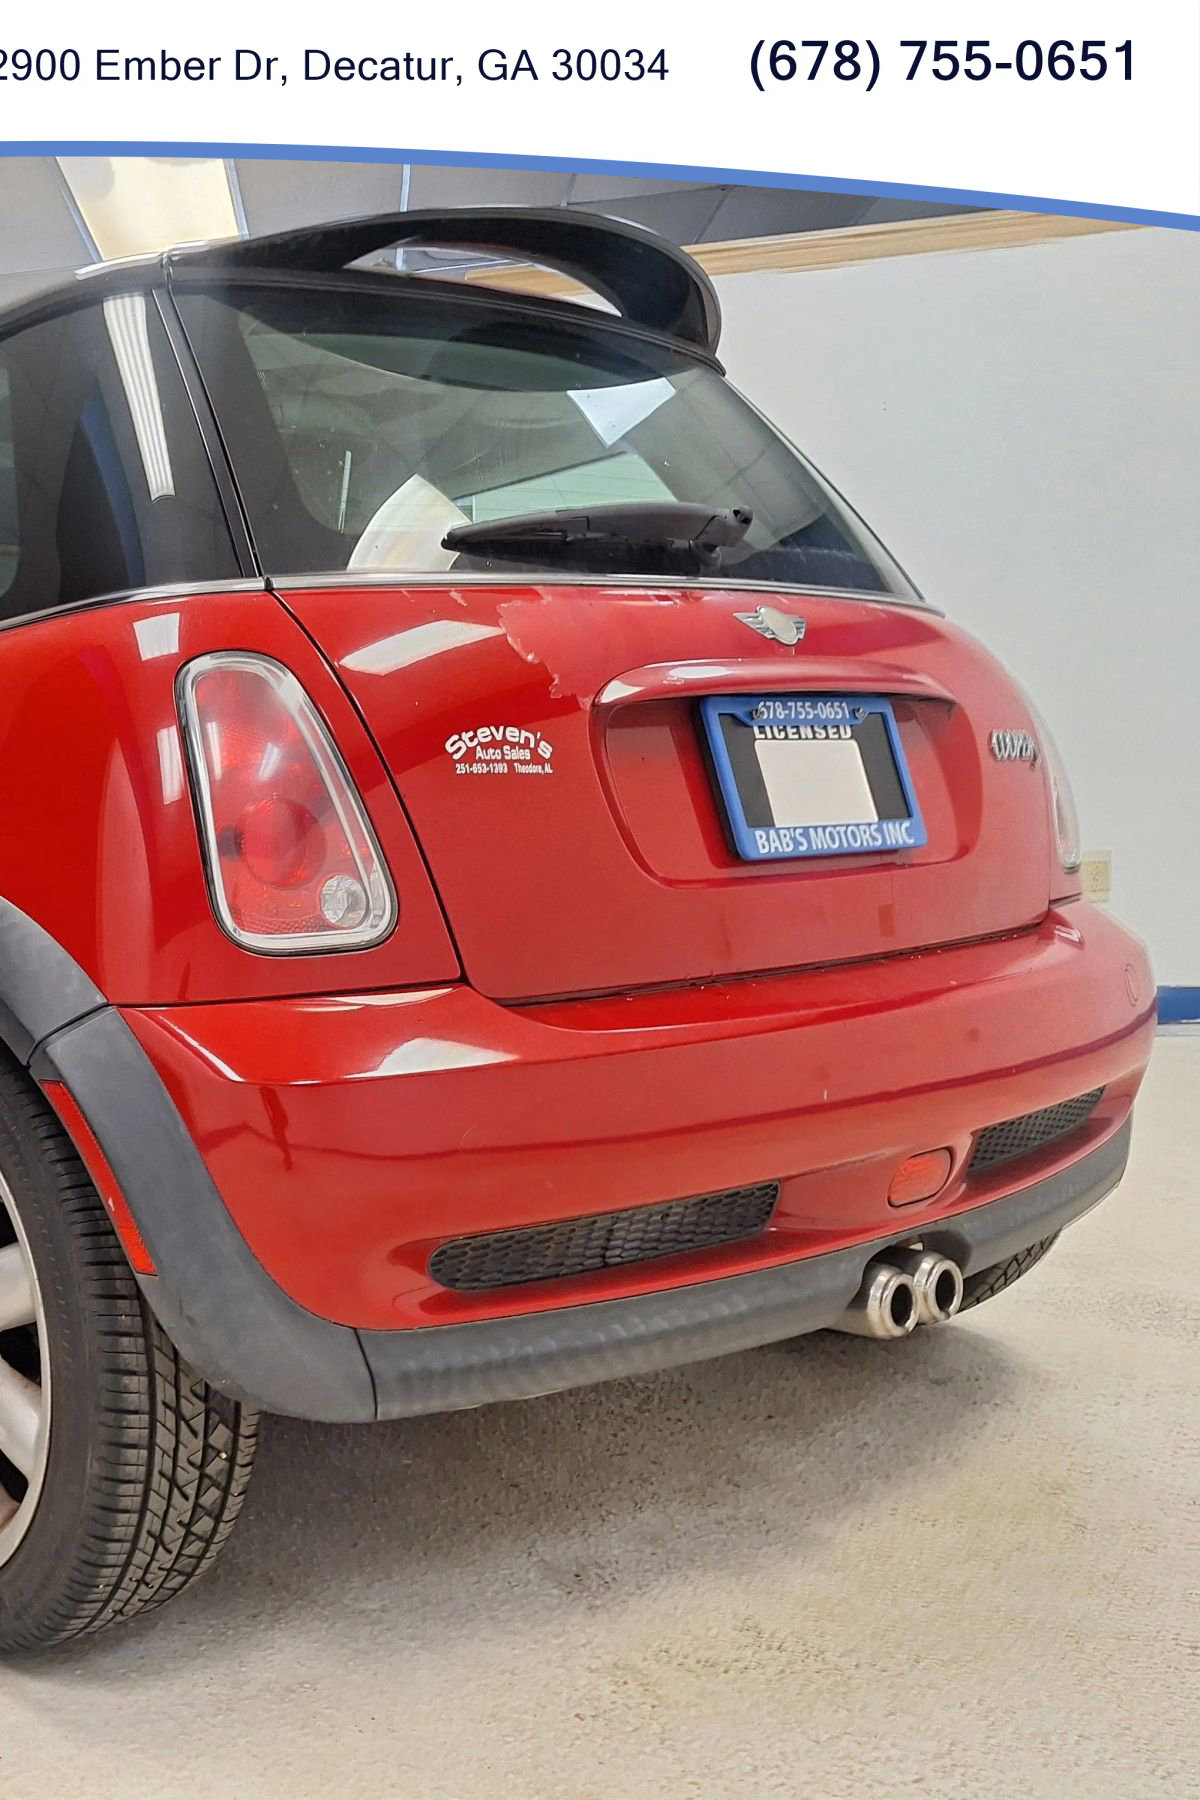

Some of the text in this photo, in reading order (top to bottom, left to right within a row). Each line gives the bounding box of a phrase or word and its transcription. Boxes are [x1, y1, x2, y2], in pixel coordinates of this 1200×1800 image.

[756, 701, 850, 719] 678-755-0651
[445, 725, 553, 760] Steven's
[475, 744, 531, 760] Auto Sales
[754, 821, 915, 854] BAB'S MOTORS INC
